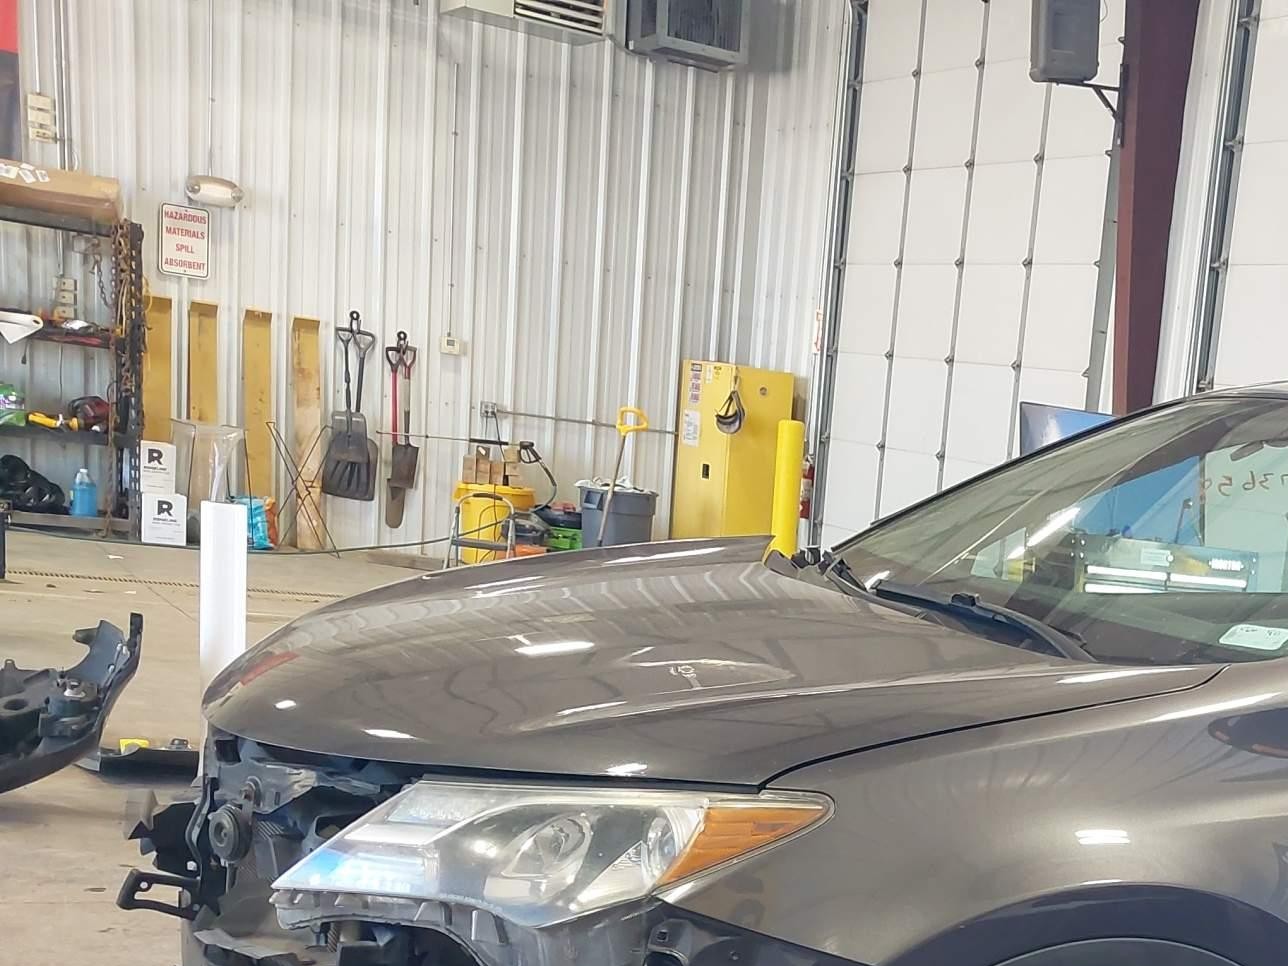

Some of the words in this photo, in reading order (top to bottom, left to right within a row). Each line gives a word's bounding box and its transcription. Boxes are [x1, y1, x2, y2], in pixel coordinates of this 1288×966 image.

[164, 209, 207, 225] HAZARDOUS
[165, 225, 205, 240] MATERIALS
[175, 243, 194, 254] SPILL
[164, 257, 206, 271] ABSORBENT
